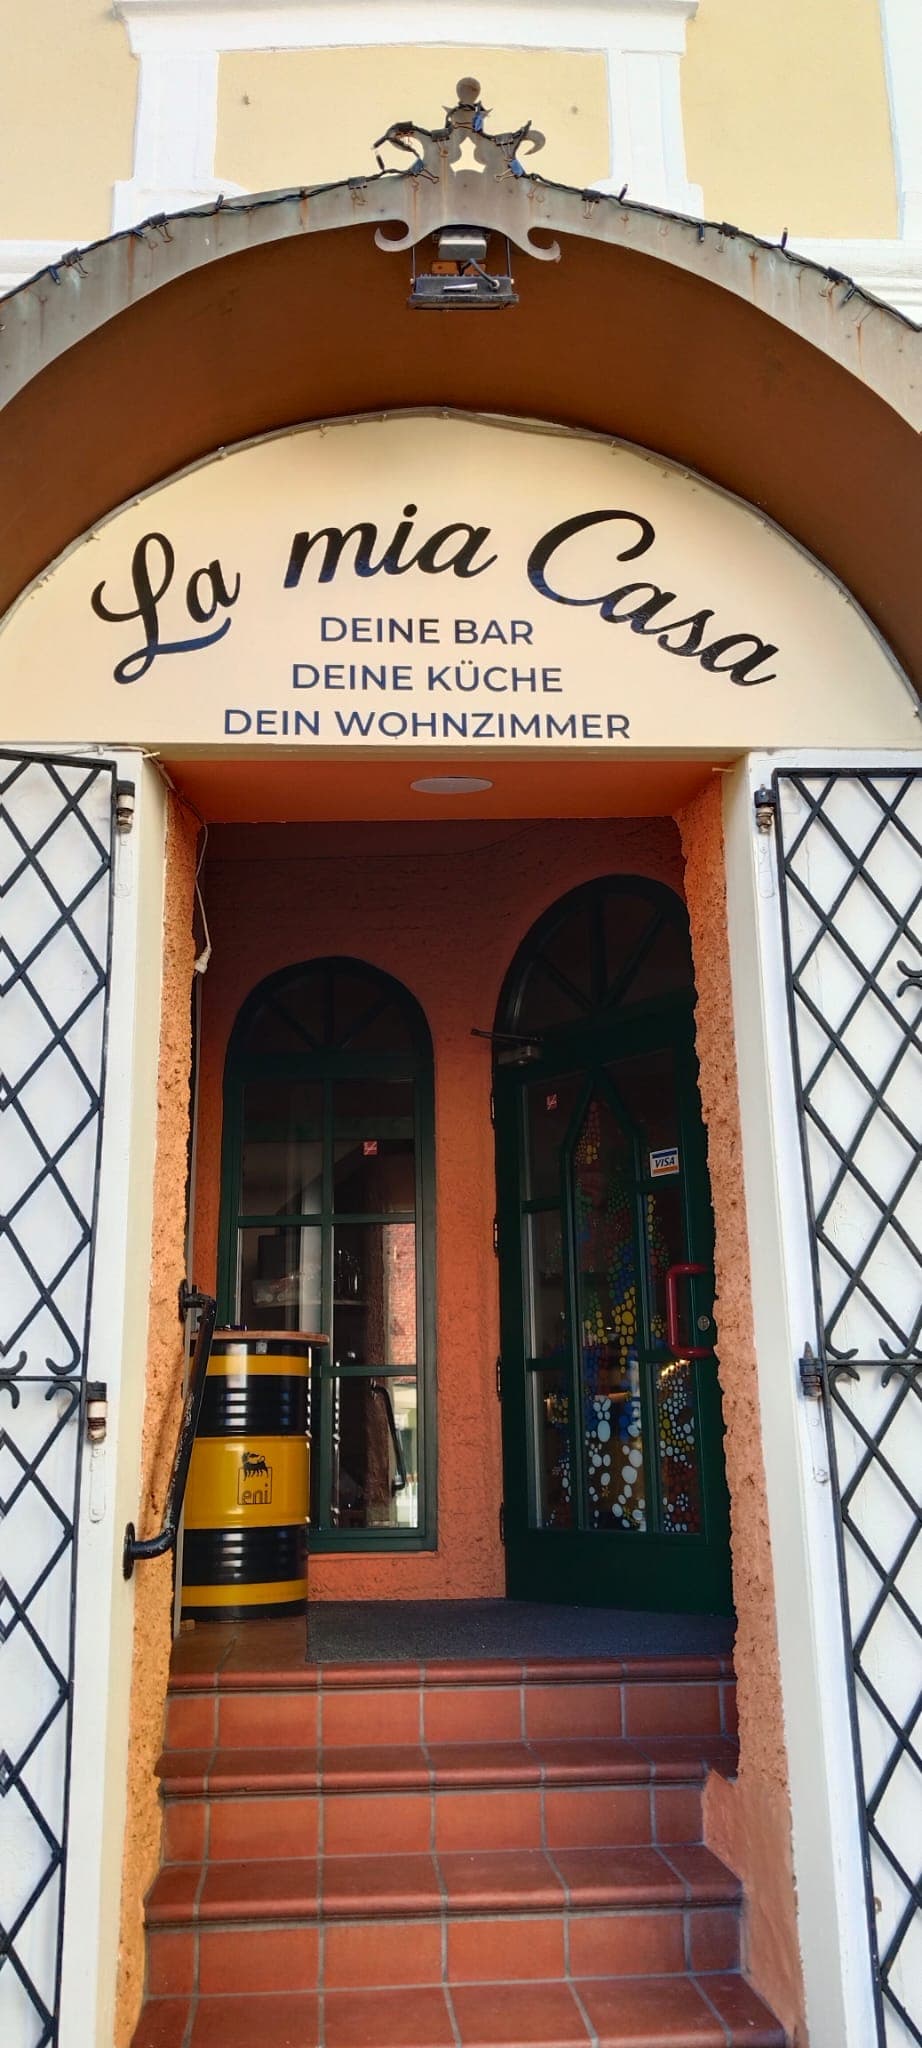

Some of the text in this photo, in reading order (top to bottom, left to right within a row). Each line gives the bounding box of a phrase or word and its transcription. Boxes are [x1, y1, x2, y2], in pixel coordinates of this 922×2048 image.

[91, 503, 779, 687] La mia Casa
[321, 617, 533, 645] DEINE BAR
[293, 660, 563, 692] DEINE KÜCHE
[224, 709, 631, 739] DEIN WOHNZIMMER
[655, 1157, 675, 1168] VISA
[242, 1483, 269, 1504] eni
